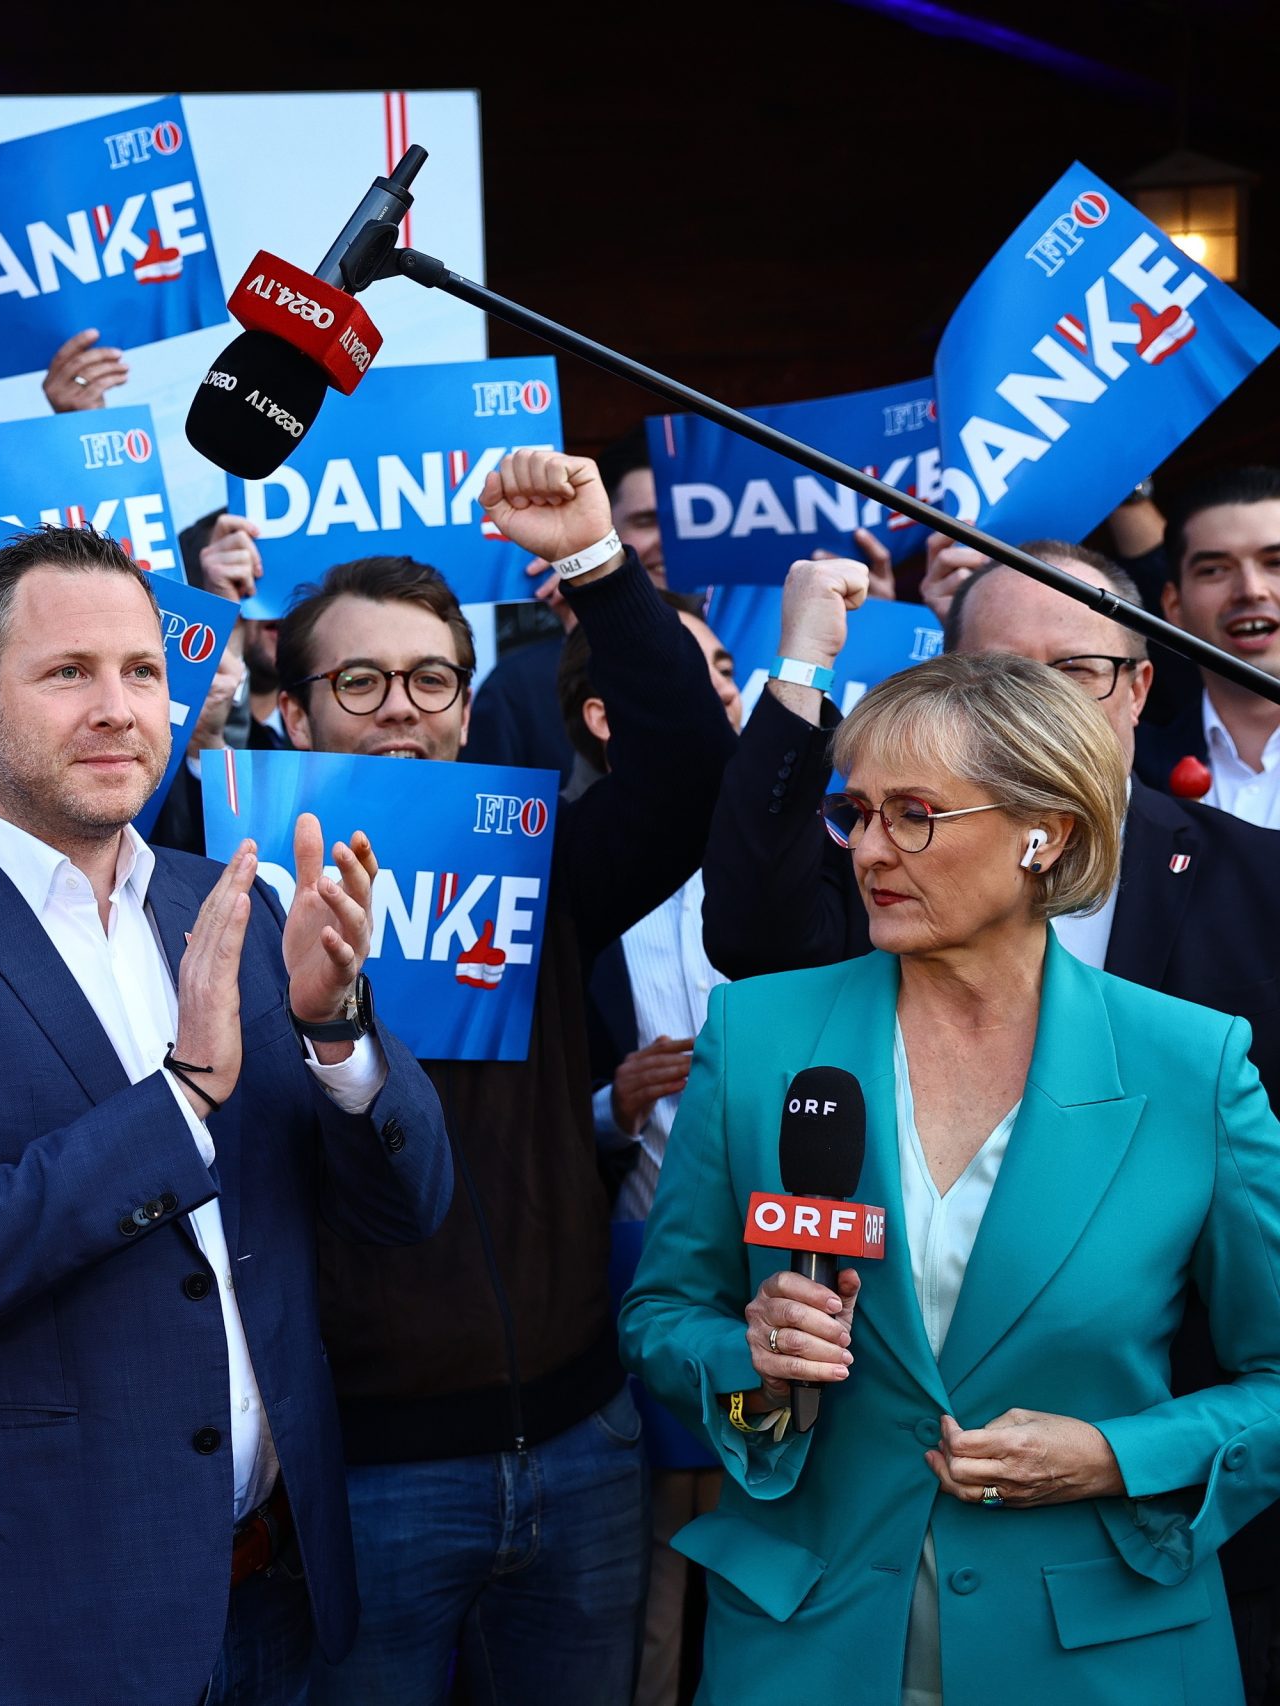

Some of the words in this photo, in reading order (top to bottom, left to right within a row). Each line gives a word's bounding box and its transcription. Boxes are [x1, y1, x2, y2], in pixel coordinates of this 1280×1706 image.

[242, 444, 555, 540] DANK
[159, 607, 216, 663] PO
[257, 861, 541, 965] NKE
[788, 1098, 838, 1116] ORF
[754, 1201, 857, 1239] ORF
[864, 1213, 884, 1245] ORF
